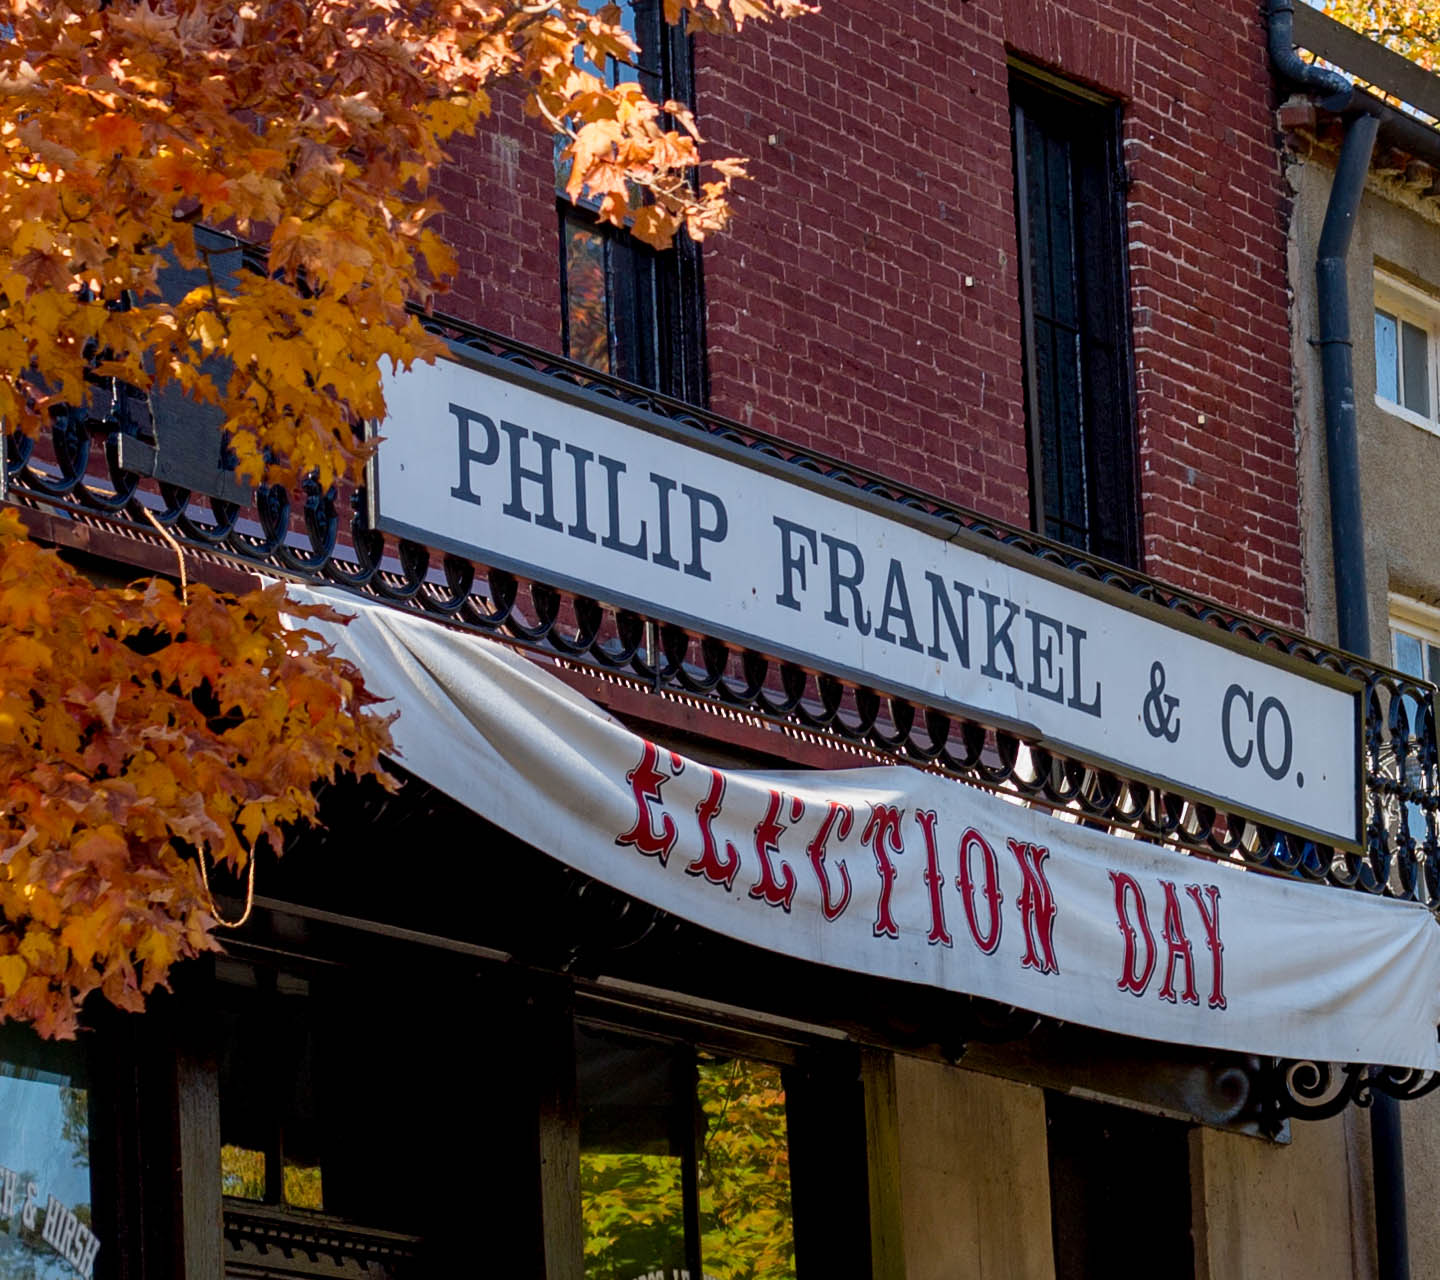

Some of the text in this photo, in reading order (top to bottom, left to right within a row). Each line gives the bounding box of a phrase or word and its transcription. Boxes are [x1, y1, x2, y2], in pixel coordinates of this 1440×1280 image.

[448, 402, 1304, 789] PHILIP FRANKEL & CO.
[616, 738, 1228, 1009] ELECTION DAY
[22, 1181, 38, 1231] &
[42, 1193, 101, 1280] HIRSH
